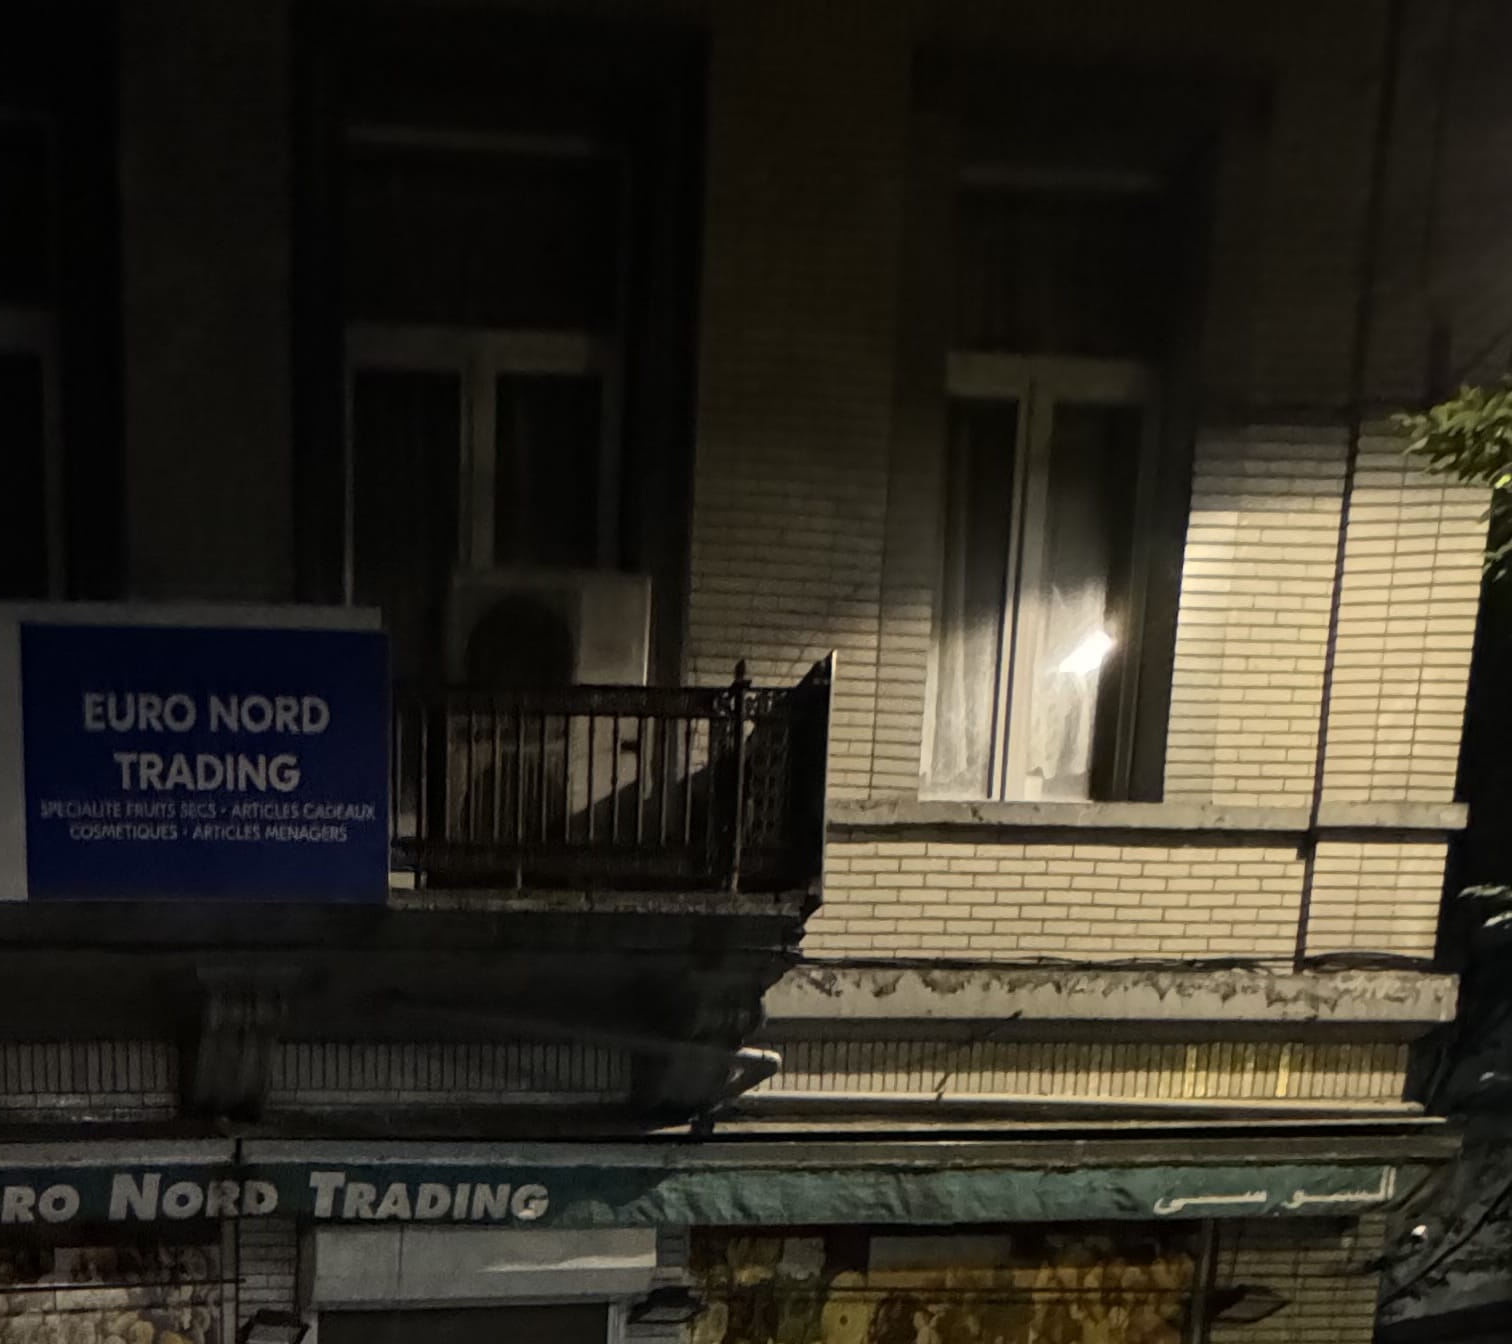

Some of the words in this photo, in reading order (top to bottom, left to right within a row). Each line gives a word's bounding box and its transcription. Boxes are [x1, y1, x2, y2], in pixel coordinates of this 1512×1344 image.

[82, 690, 198, 734] EURO
[208, 694, 331, 735] NORD
[113, 751, 302, 793] TRADING
[125, 800, 177, 820] FRUITS
[179, 801, 217, 820] SECS
[230, 801, 300, 821] ARTICLES
[302, 801, 376, 821] CADEAUX
[69, 823, 179, 842] COSMETIQUES
[191, 824, 262, 842] ARTICLES
[264, 824, 349, 844] MENAGERS
[107, 1172, 279, 1222] NORD
[308, 1170, 550, 1221] TRADING
